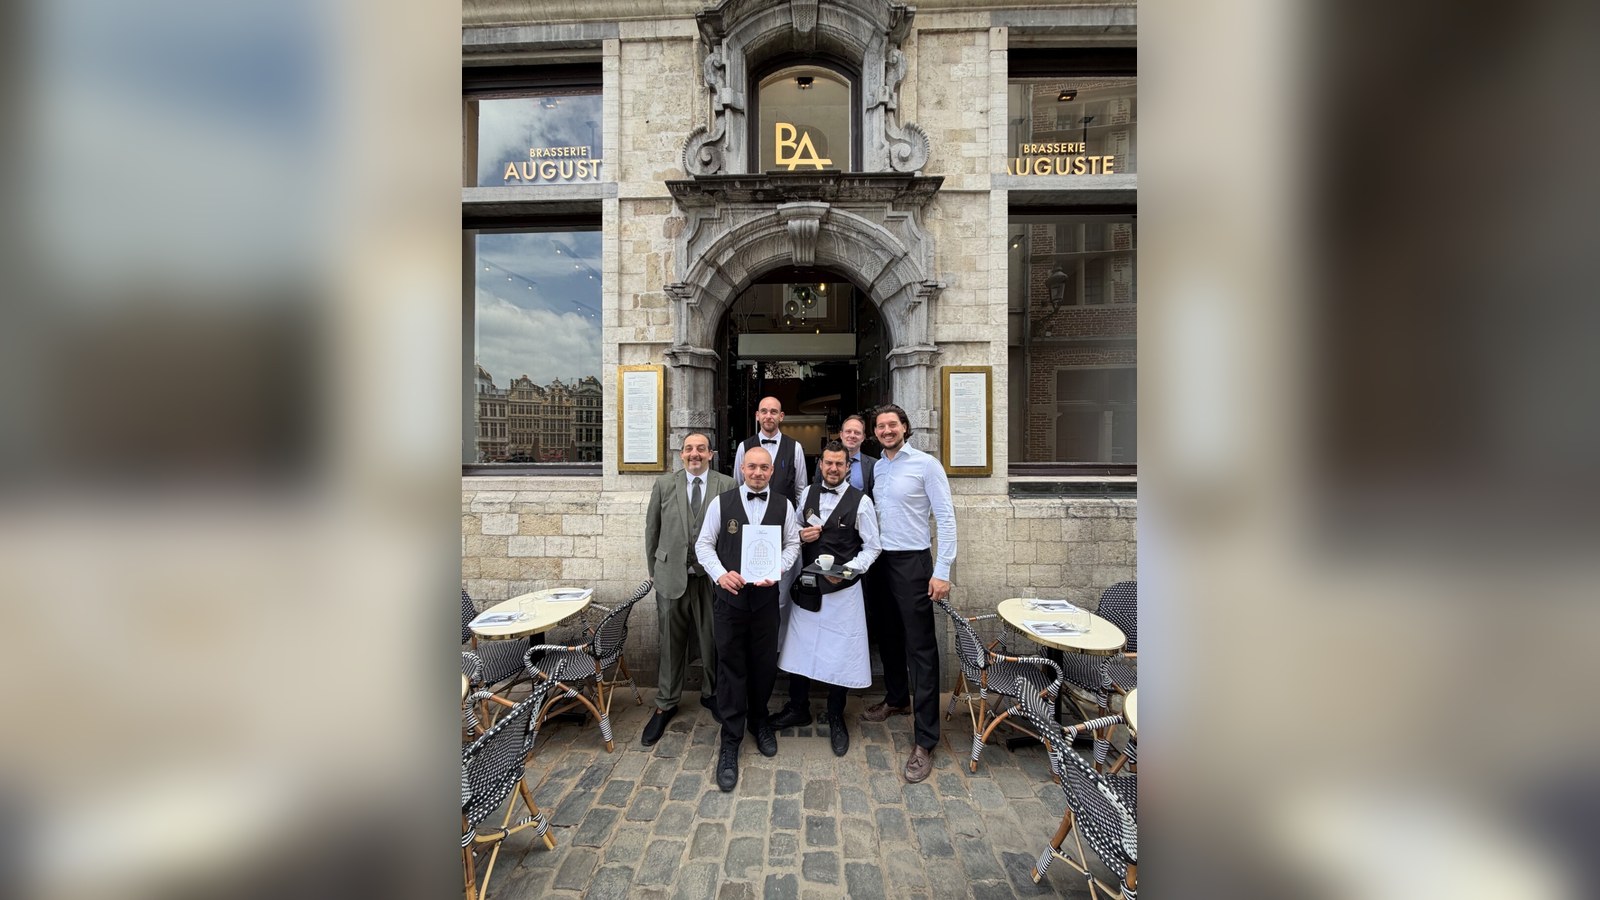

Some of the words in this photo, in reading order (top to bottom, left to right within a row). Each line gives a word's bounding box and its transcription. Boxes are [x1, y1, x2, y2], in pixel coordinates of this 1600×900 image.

[530, 146, 587, 158] BRASSERIE
[776, 123, 832, 170] BA
[1023, 142, 1086, 154] BRASSERIE
[503, 159, 600, 180] AUGUST
